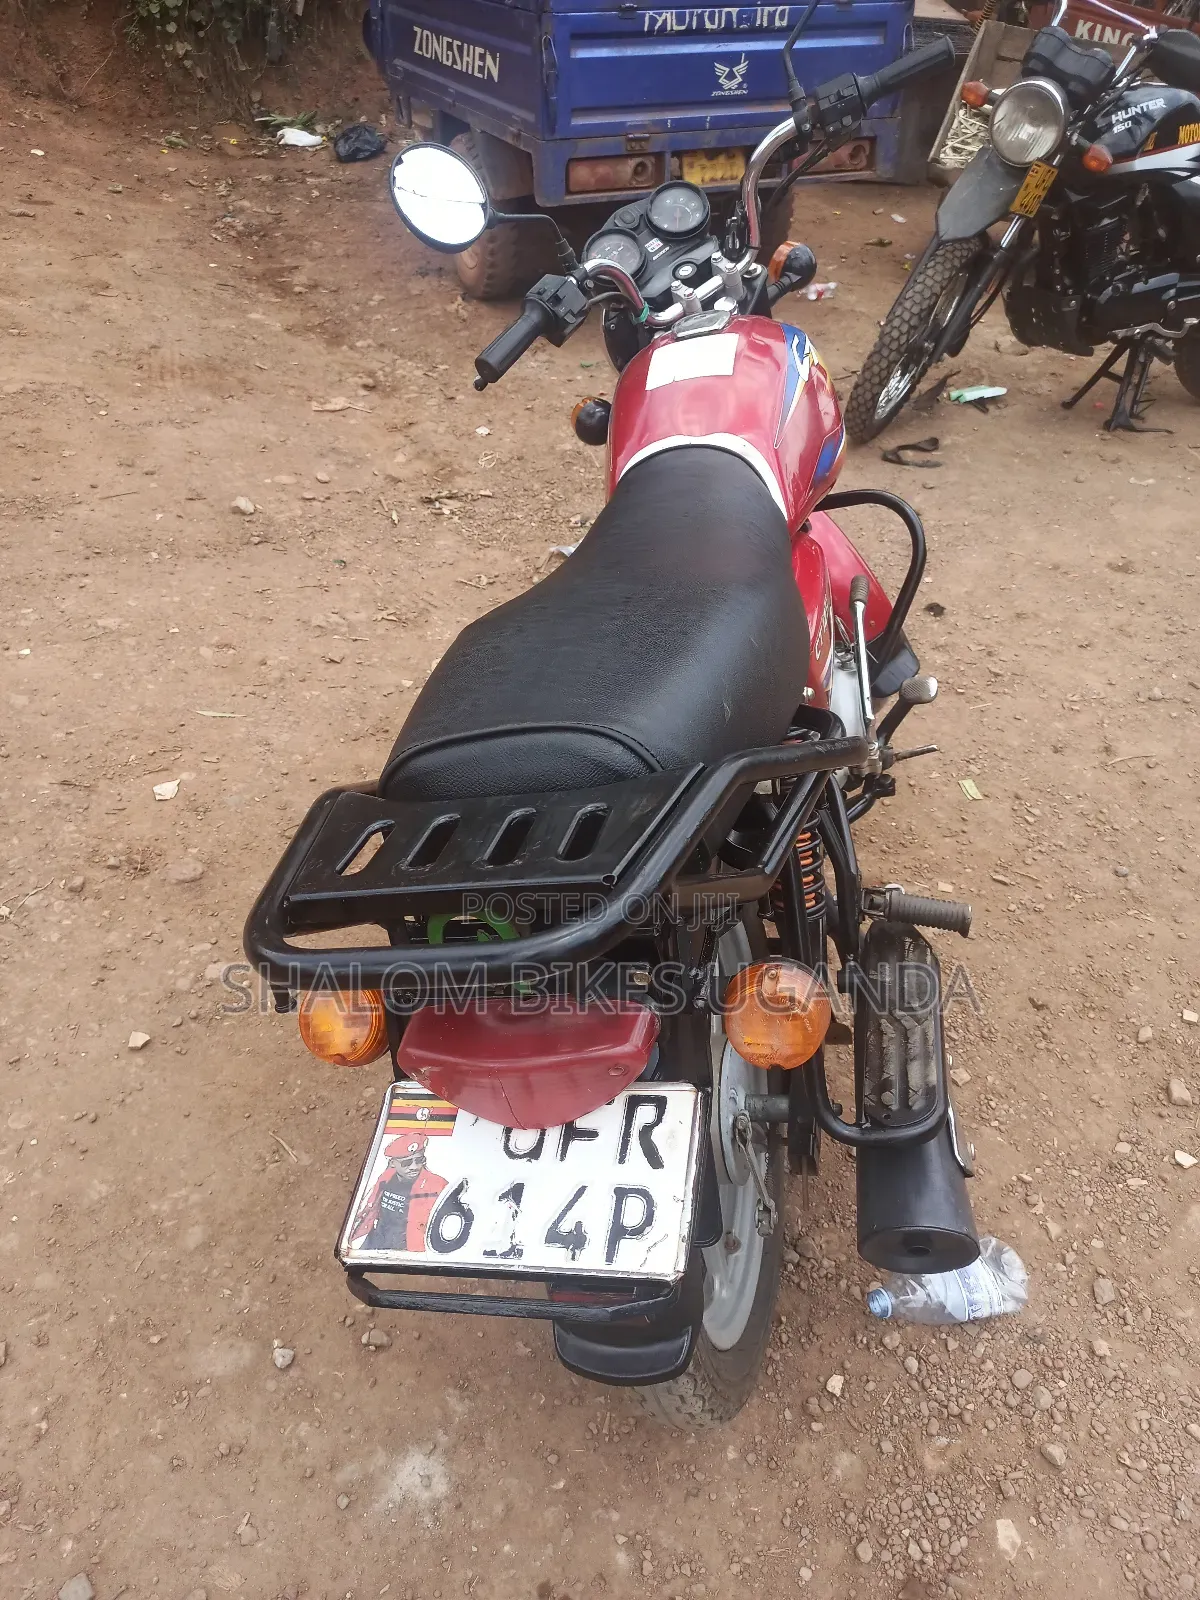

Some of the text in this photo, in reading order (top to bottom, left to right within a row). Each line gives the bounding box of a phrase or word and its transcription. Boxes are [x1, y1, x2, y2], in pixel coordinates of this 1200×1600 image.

[413, 25, 500, 83] ZONGSHEN
[1111, 98, 1167, 124] HUNTER
[1112, 120, 1132, 134] 150
